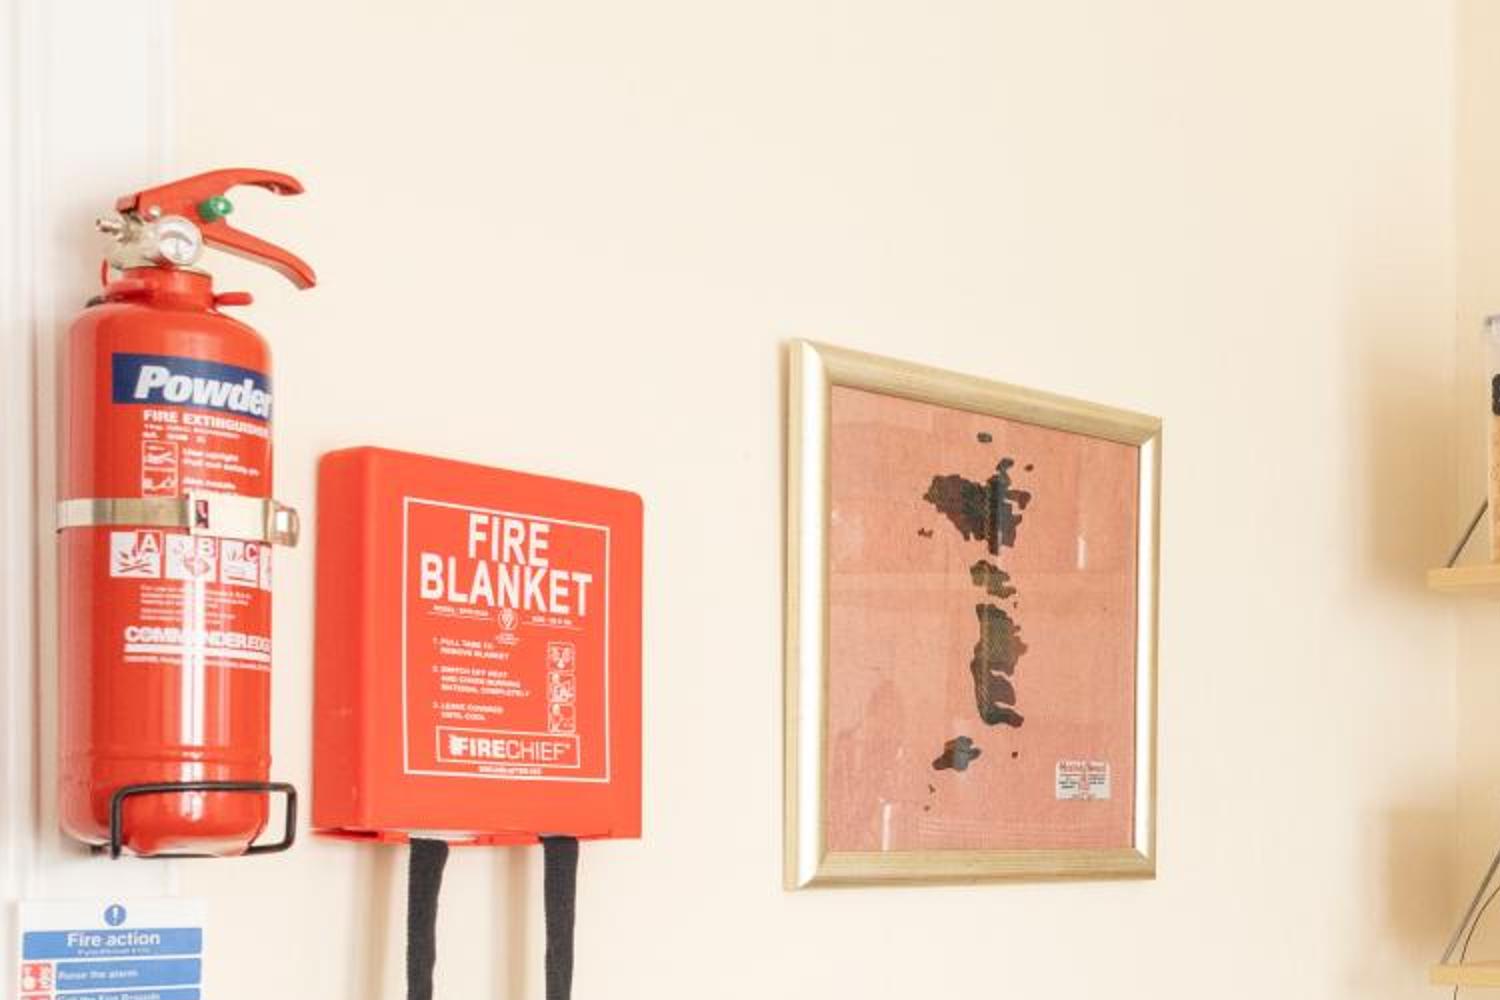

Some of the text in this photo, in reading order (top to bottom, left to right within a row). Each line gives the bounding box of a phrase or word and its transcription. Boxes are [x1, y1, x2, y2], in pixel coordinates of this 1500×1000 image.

[134, 364, 273, 417] Powder
[144, 409, 179, 423] FIRE
[140, 534, 159, 553] A
[199, 538, 215, 556] B
[468, 512, 551, 568] FIRE
[245, 543, 258, 562] C
[419, 552, 593, 617] BLANKET
[450, 735, 567, 761] FIRECHIEF
[67, 931, 161, 947] Fire action
